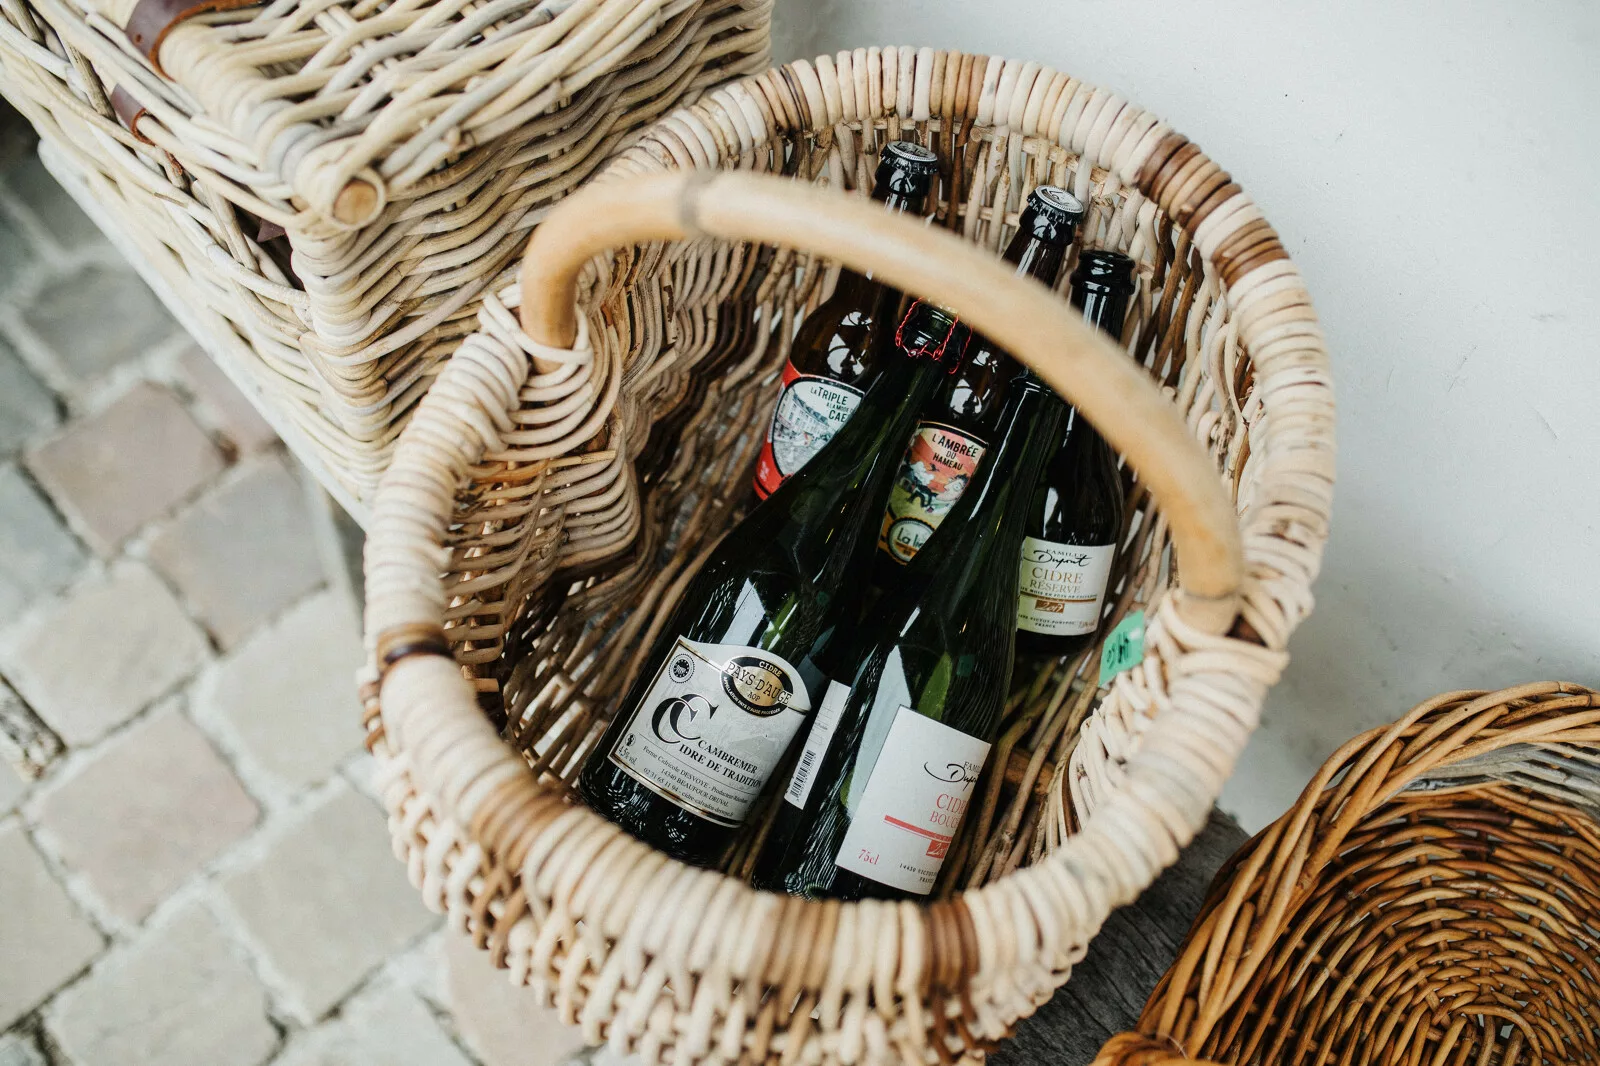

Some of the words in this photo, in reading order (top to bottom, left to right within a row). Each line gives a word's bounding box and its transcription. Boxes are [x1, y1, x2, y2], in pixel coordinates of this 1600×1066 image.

[817, 386, 849, 406] TRIPLE
[932, 452, 964, 471] HAMEAU
[945, 450, 957, 460] DU
[897, 527, 911, 545] La
[1023, 550, 1094, 569] Dupont
[1046, 548, 1086, 558] FAMILLE
[1031, 566, 1084, 585] CIDRE
[1029, 579, 1081, 594] RÉSERVE
[758, 660, 783, 678] CIDRE
[725, 660, 756, 686] PAYS
[755, 678, 793, 705] D'AUGE
[747, 691, 761, 702] AOP
[697, 739, 759, 775] CAMBREMER
[706, 759, 723, 773] DE
[643, 745, 659, 759] Ferme
[680, 769, 709, 789] DESVOYE
[643, 767, 650, 775] 02
[858, 848, 880, 866] 75cl
